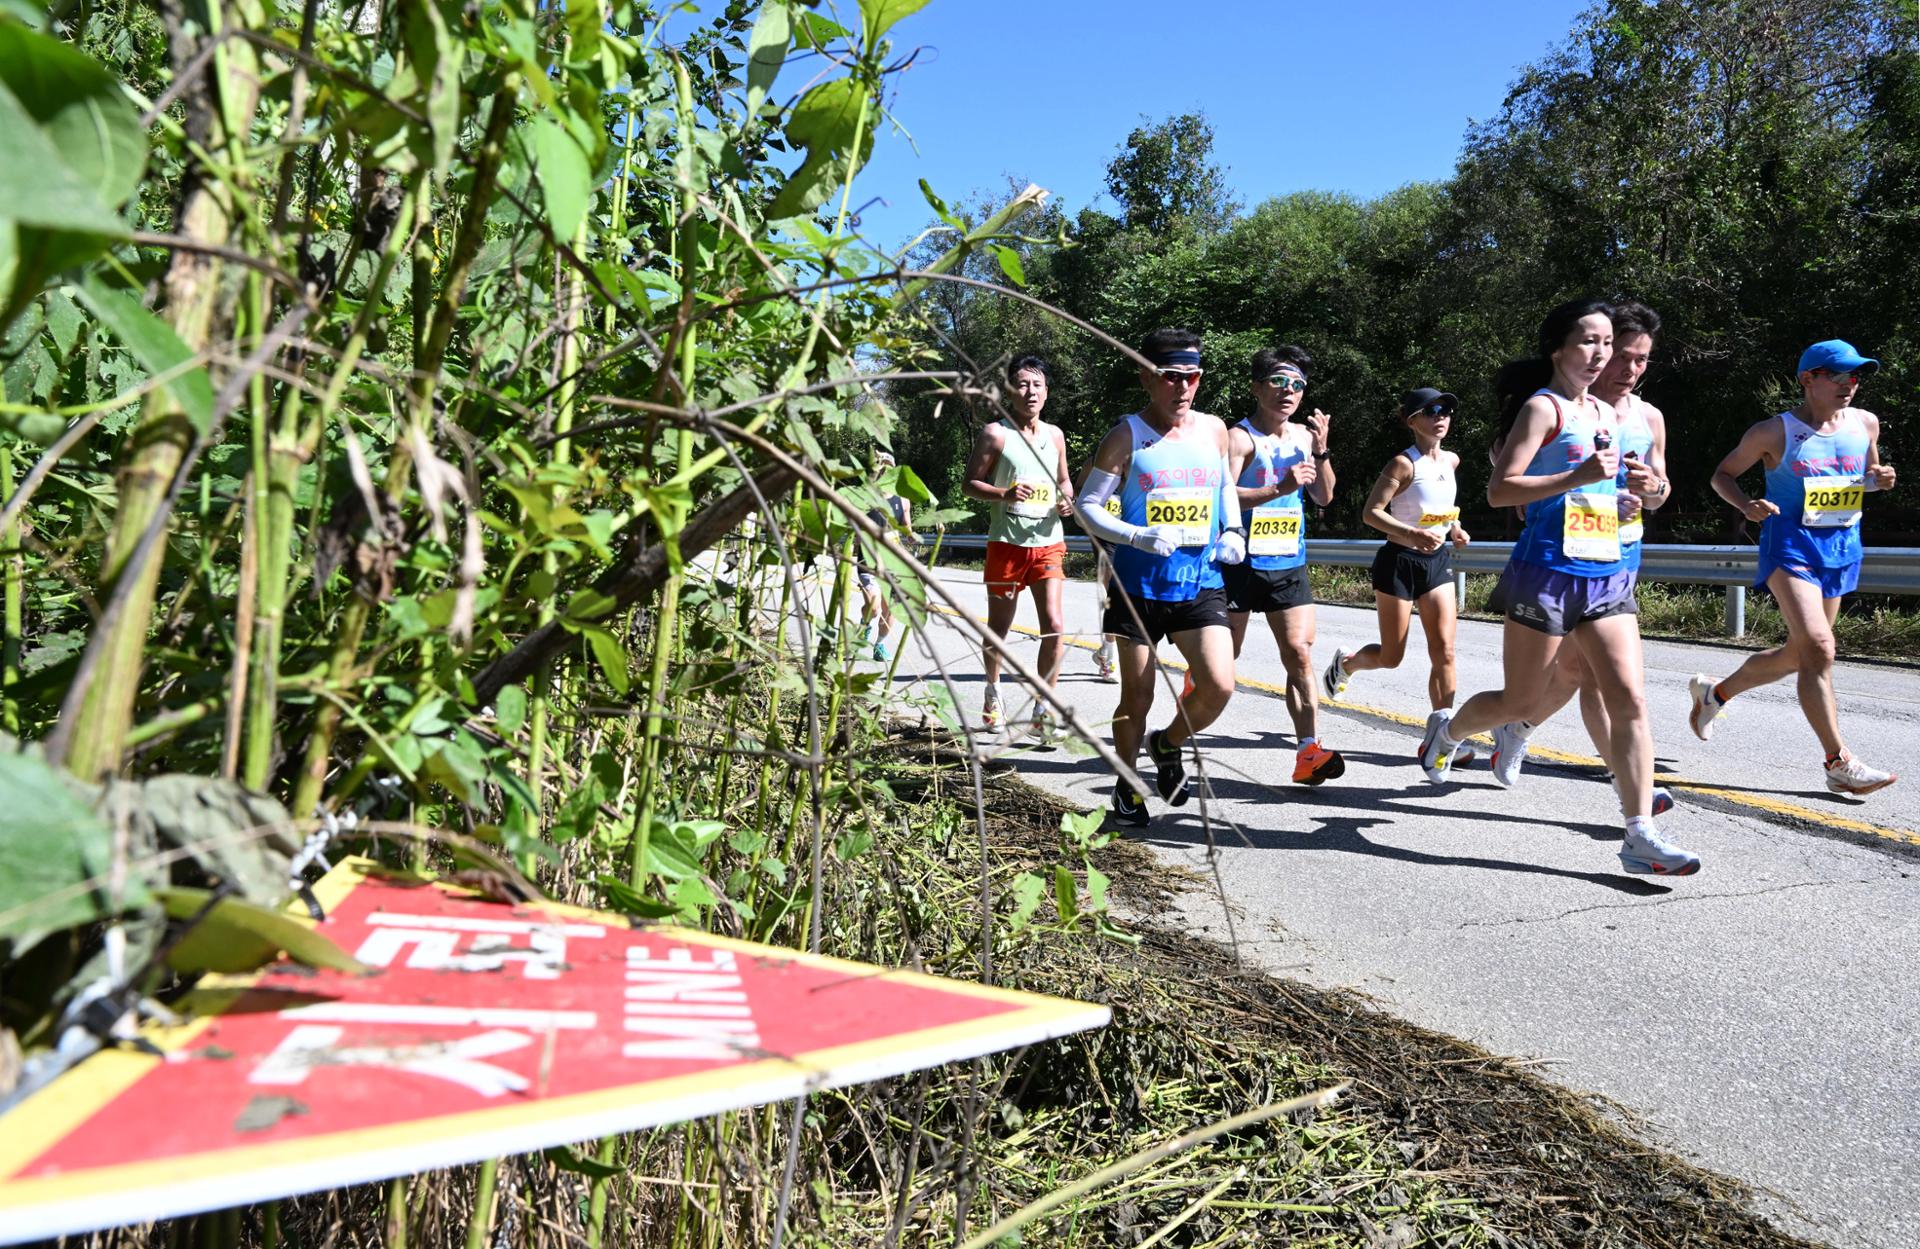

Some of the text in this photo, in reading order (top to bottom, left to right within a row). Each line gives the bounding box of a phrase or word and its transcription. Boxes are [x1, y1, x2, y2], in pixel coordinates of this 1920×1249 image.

[1809, 491, 1860, 507] 20317
[1150, 505, 1209, 522] 20324
[1253, 521, 1297, 535] 20334
[623, 946, 761, 1059] MINE
